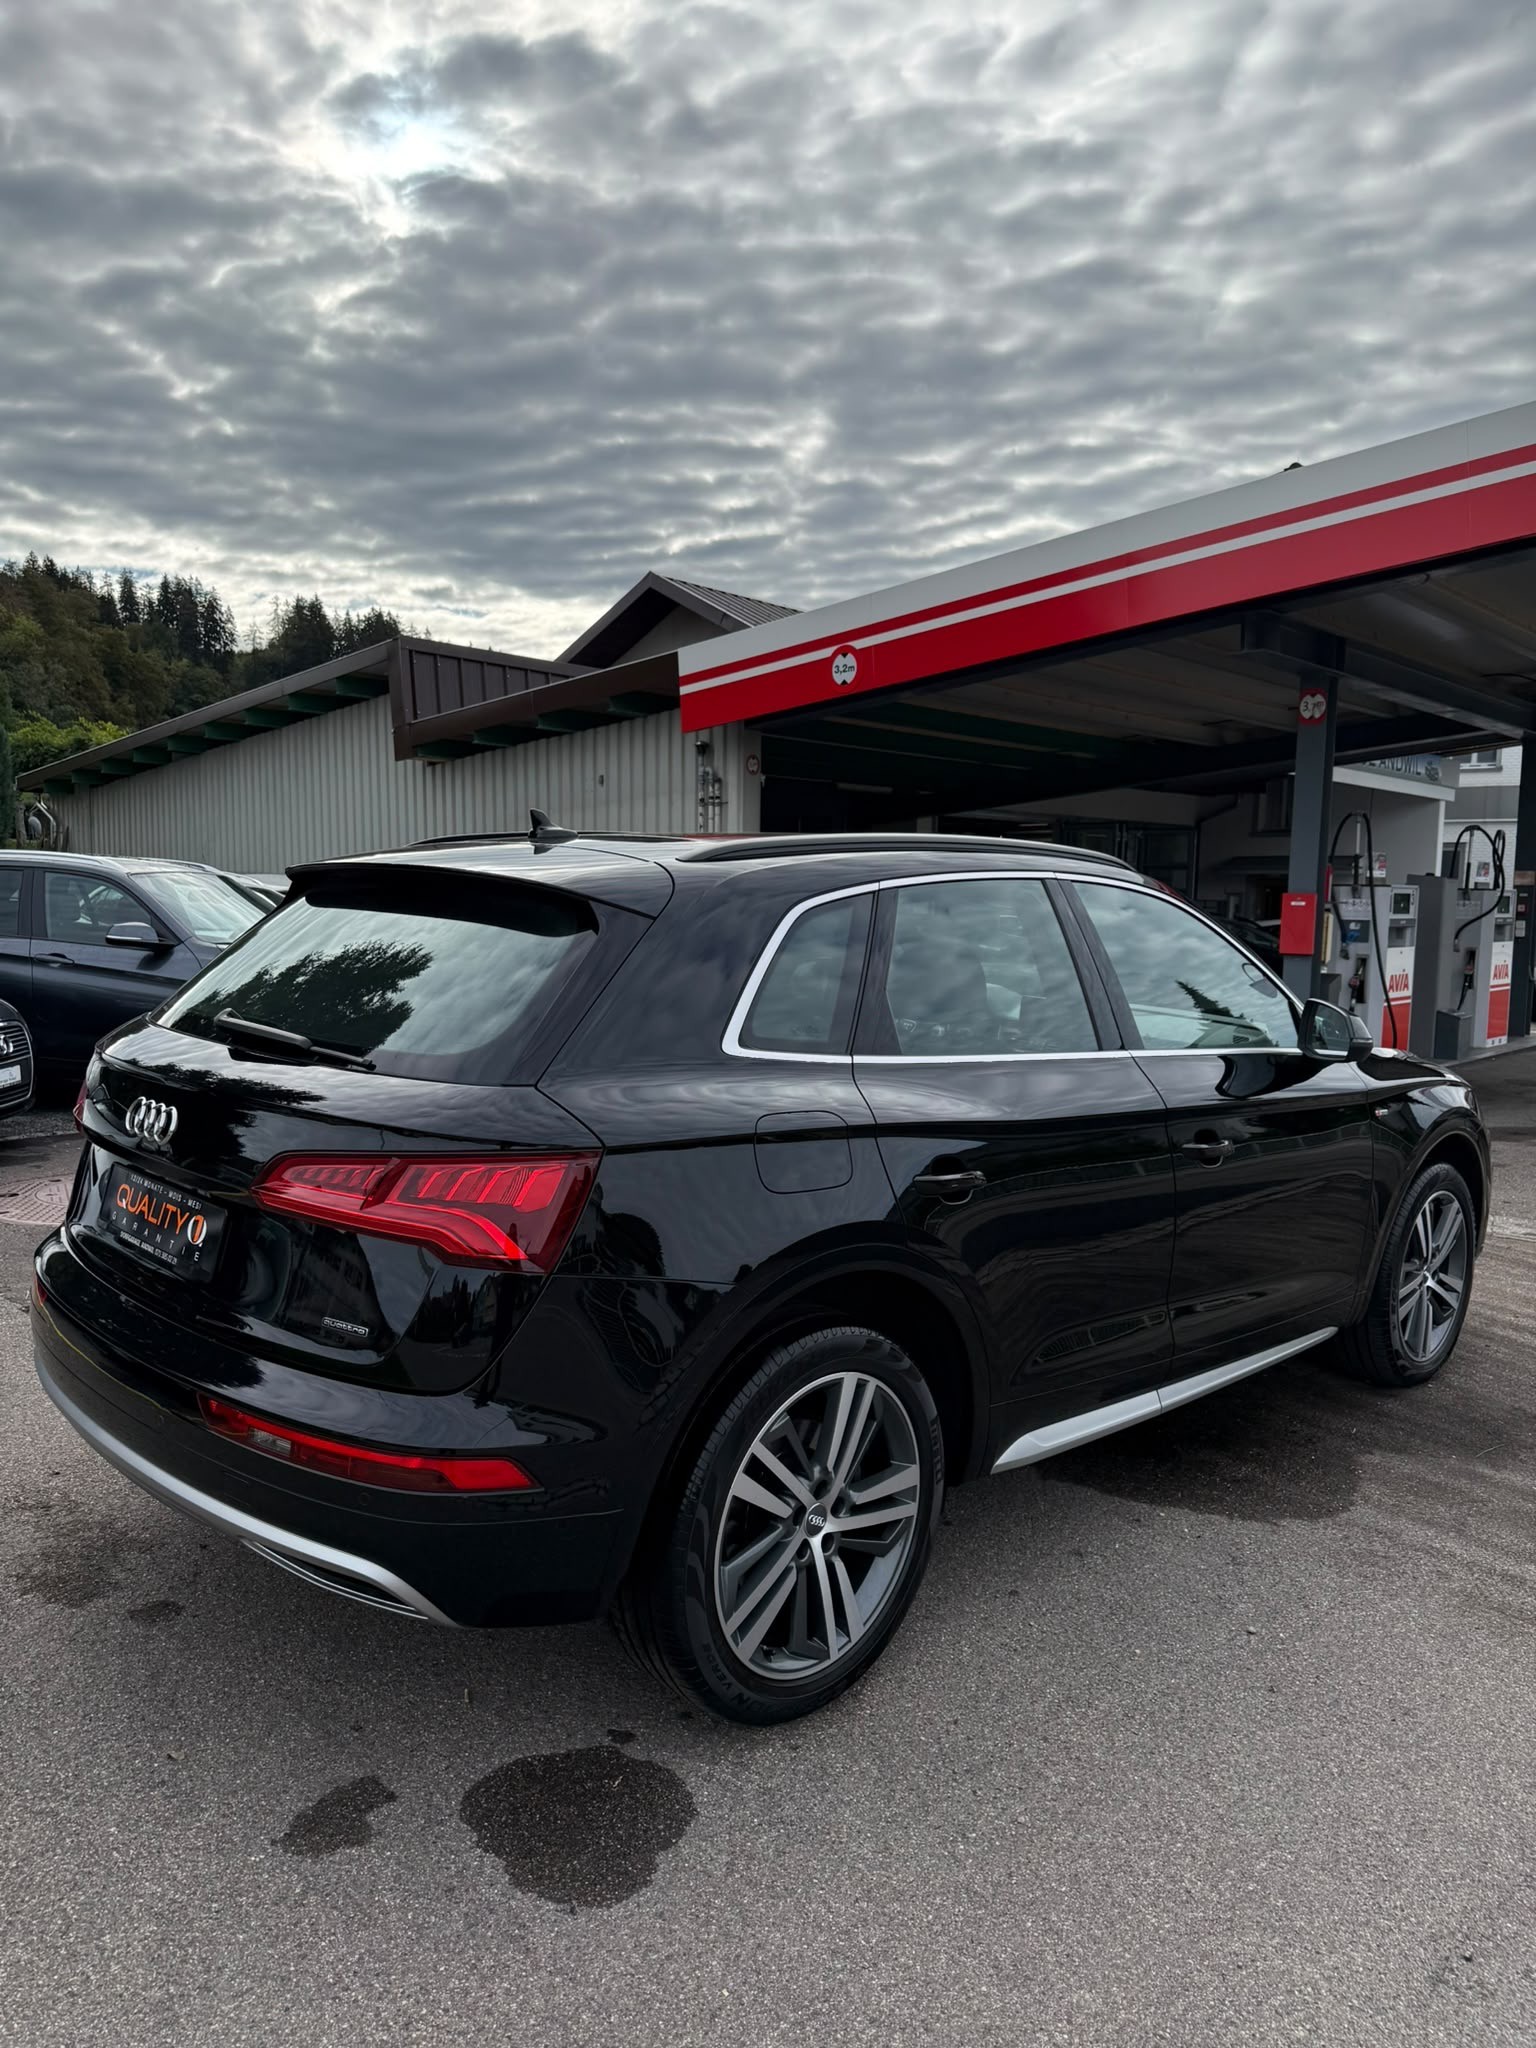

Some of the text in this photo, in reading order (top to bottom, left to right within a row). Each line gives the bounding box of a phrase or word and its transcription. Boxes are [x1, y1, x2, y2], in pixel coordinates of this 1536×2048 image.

[834, 664, 855, 675] 3,2m
[1493, 960, 1509, 980] AVIA
[1388, 970, 1409, 993] AVIA
[112, 1211, 200, 1261] GARANTIE
[322, 1319, 366, 1335] quattro
